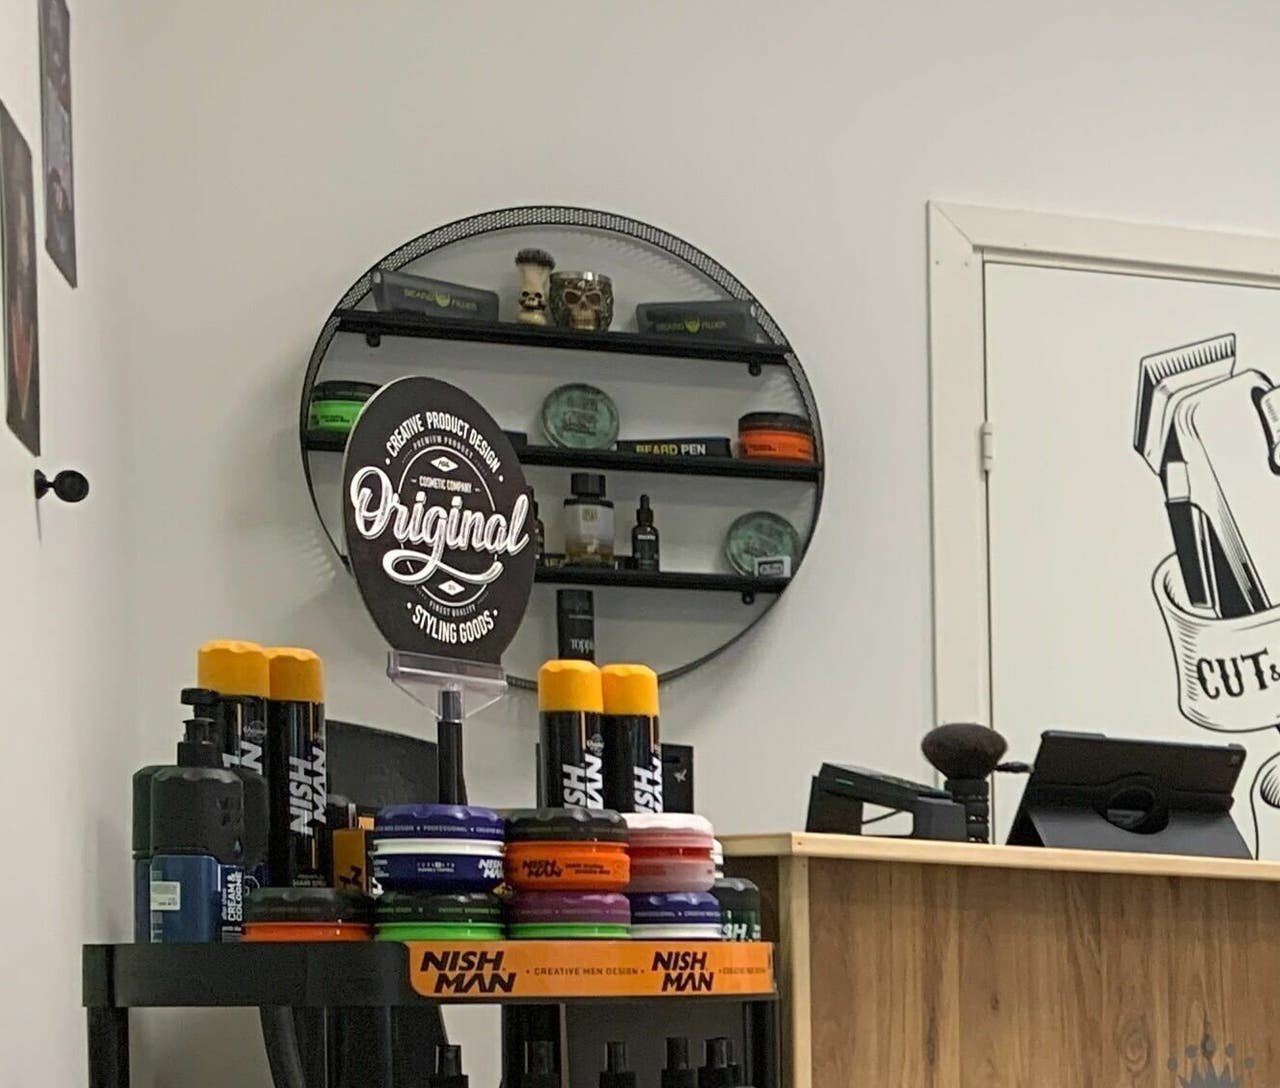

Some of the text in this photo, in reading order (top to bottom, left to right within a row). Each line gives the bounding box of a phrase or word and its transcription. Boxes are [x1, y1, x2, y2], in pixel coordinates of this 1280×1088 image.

[386, 411, 501, 473] CREATIVE PRODUCT DESIGN
[636, 444, 706, 456] BEARD PEN
[419, 475, 473, 494] COSMETIC COMPANY
[350, 466, 530, 585] Original
[412, 604, 494, 644] STYLING GOODS
[1197, 648, 1270, 699] CUT
[289, 756, 313, 836] NISH
[312, 746, 328, 825] MAN
[227, 873, 236, 922] CREAM &
[234, 871, 242, 922] COLOGNE
[420, 951, 504, 971] NISH
[534, 967, 639, 976] CREATIVE MEN DESIGN
[652, 951, 706, 971] NISH
[433, 973, 516, 993] MAN
[662, 973, 713, 992] MAN
